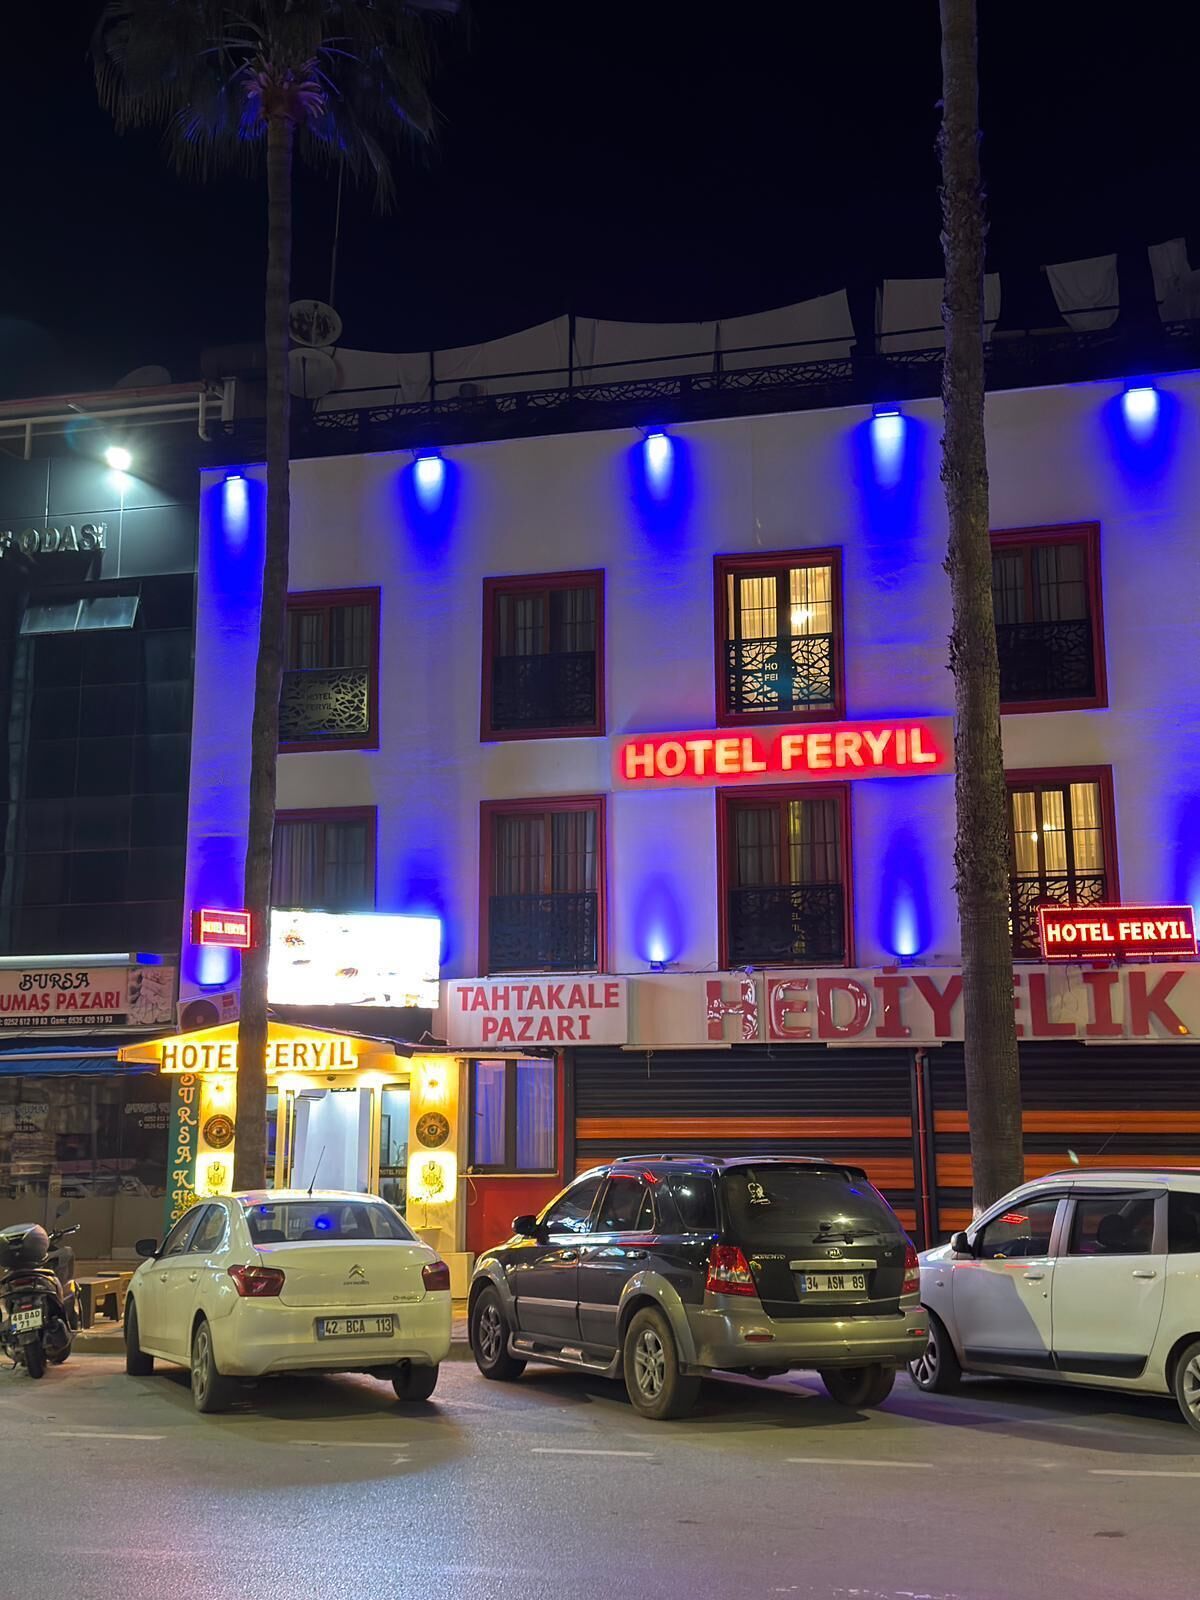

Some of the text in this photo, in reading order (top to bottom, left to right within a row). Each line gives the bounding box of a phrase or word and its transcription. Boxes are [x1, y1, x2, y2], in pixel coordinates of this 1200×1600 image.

[625, 727, 937, 779] HOTEL FERYIL
[1046, 921, 1192, 942] HOTEL FERYIL
[19, 972, 91, 991] BURSA
[56, 991, 121, 1009] PAZARI
[456, 983, 620, 1011] TAHTAKALE
[706, 963, 1189, 1039] HEDİYLİK
[481, 1015, 591, 1042] PAZARI
[161, 1041, 354, 1069] HOTE ERYIL
[807, 1276, 864, 1290] 34 ASM 89
[325, 1318, 391, 1334] 42 BCA 113
